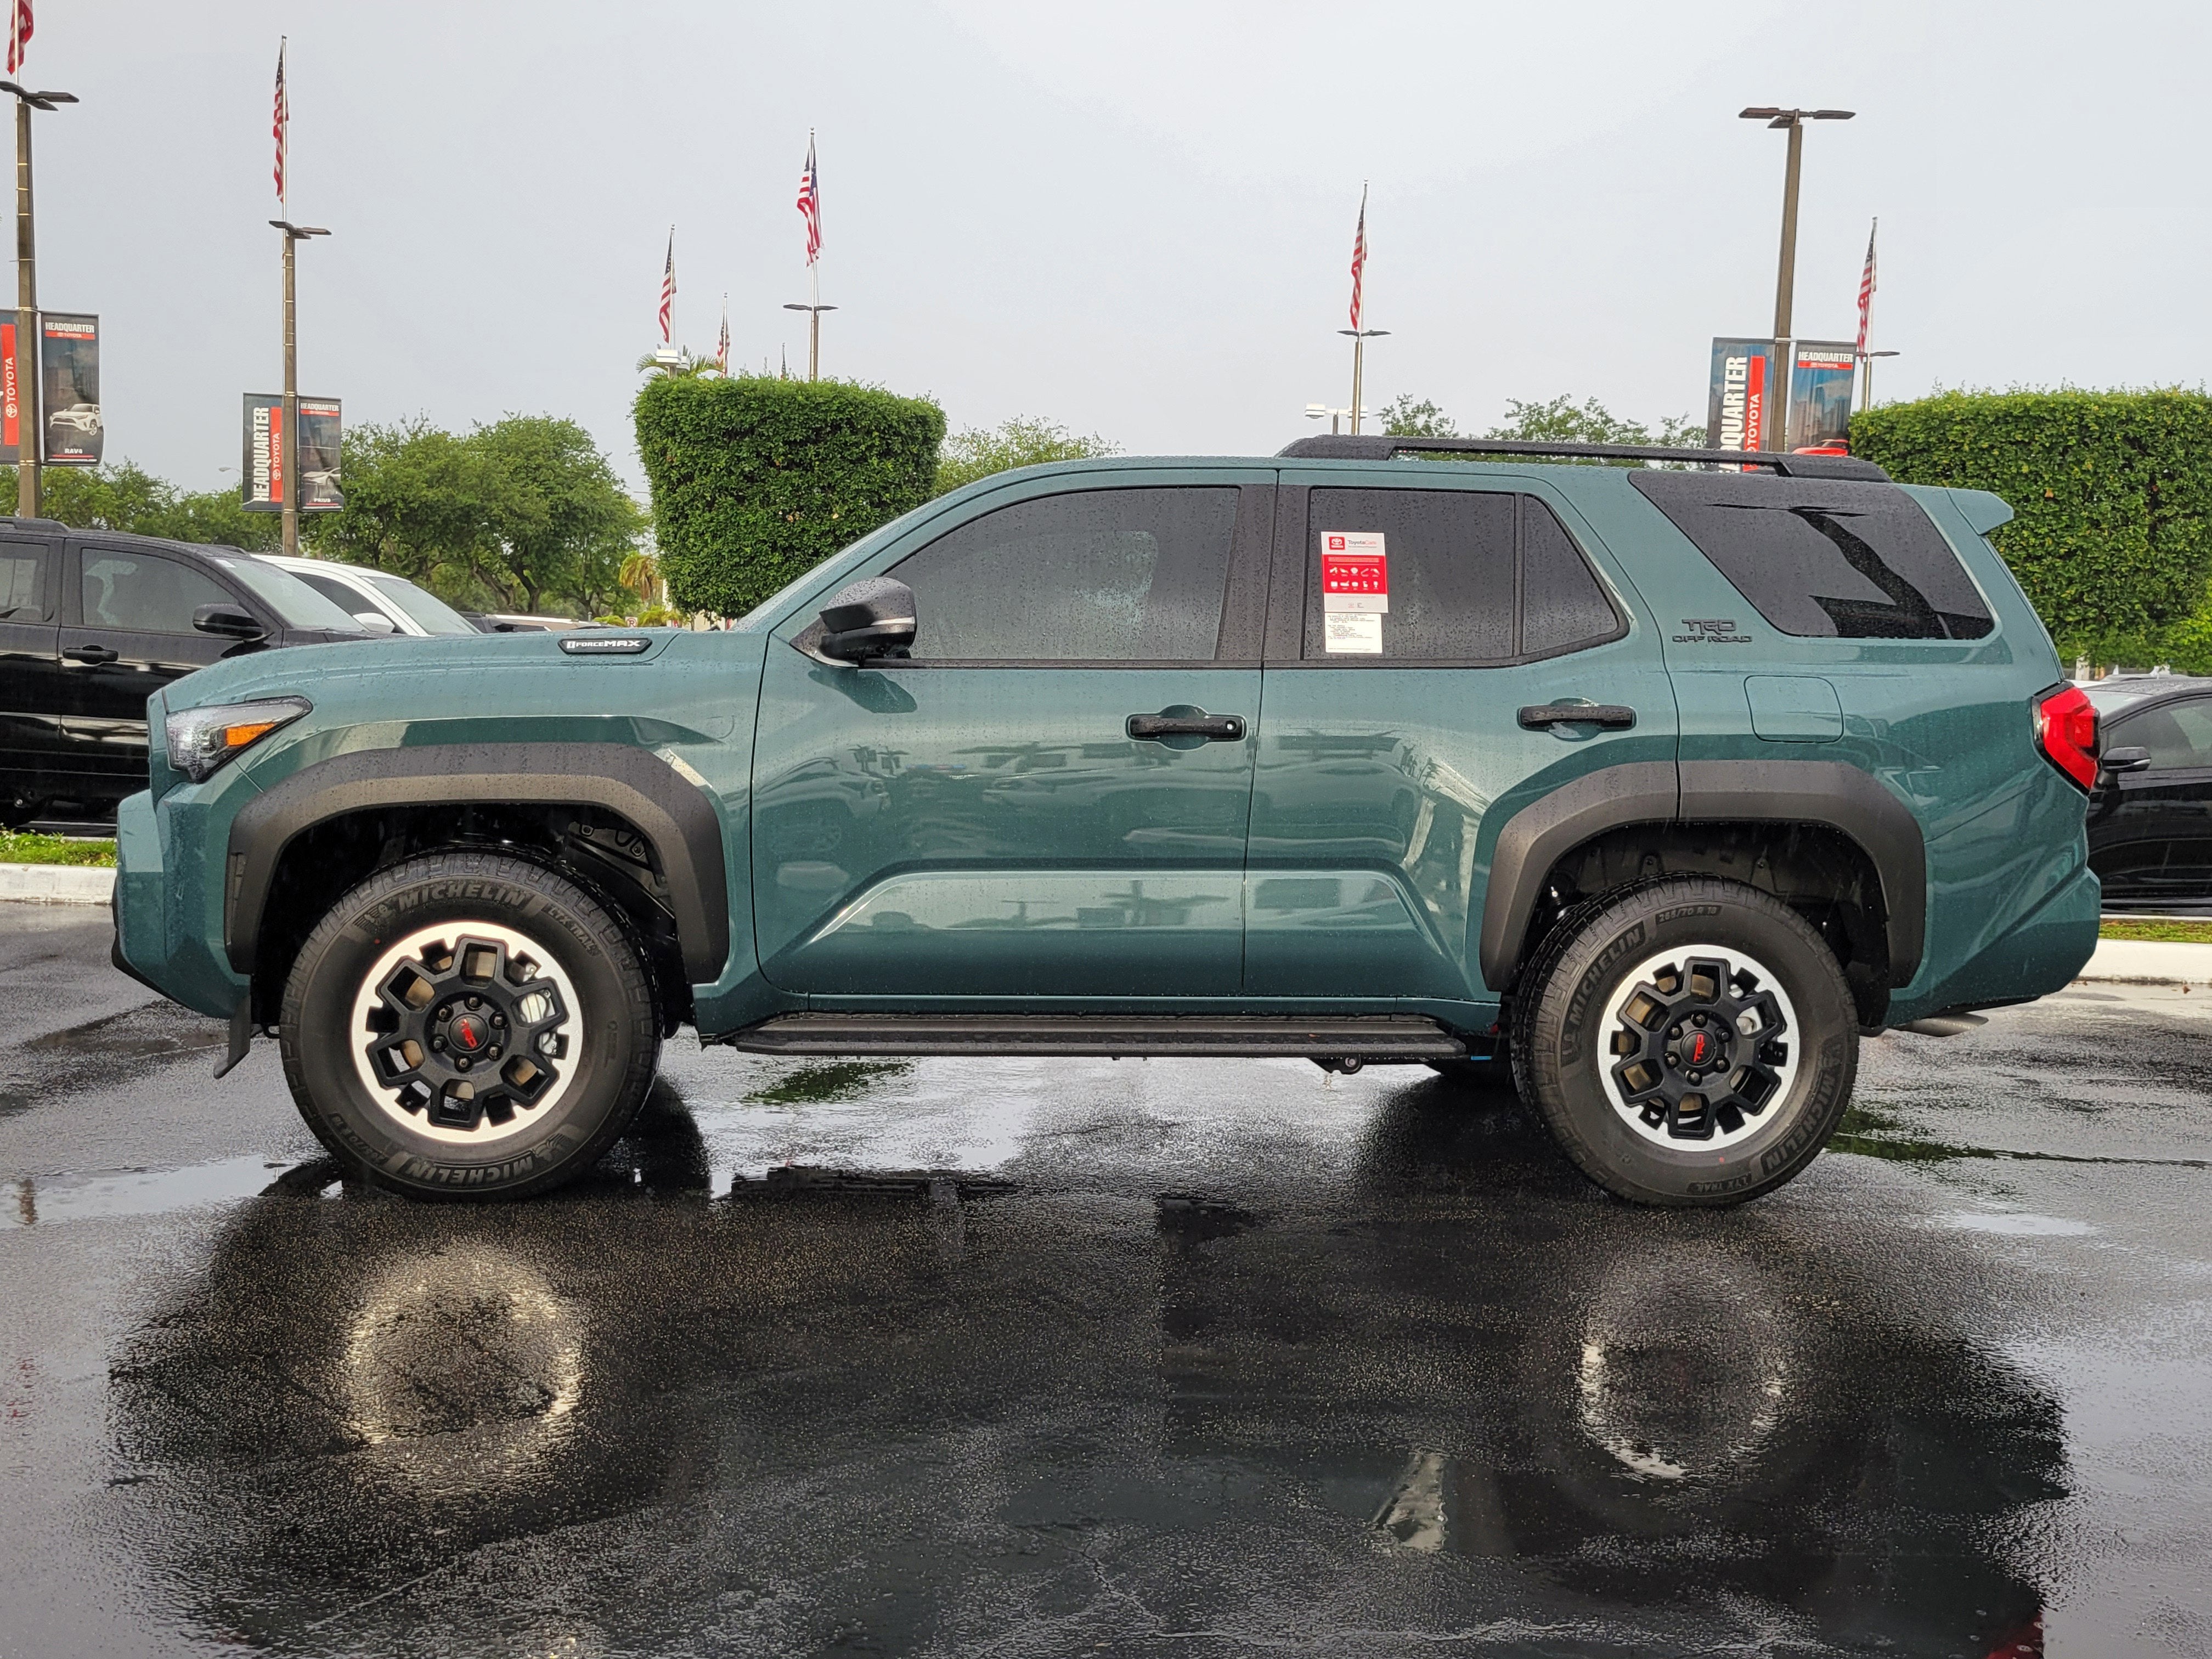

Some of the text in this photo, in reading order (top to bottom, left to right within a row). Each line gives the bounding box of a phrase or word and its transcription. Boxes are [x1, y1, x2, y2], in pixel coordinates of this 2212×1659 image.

[45, 321, 94, 333] HEADQUARTER
[1798, 351, 1853, 363] HEADQUARTER
[5, 357, 16, 403] TOYOTA
[1747, 394, 1760, 445] TOYOTA
[253, 407, 272, 501] HEADQUARTER
[1681, 619, 1736, 635] TRD
[398, 881, 526, 911] MICHELIN
[1569, 928, 1640, 1025] MICHELIN
[407, 1155, 533, 1183] MICHELIN
